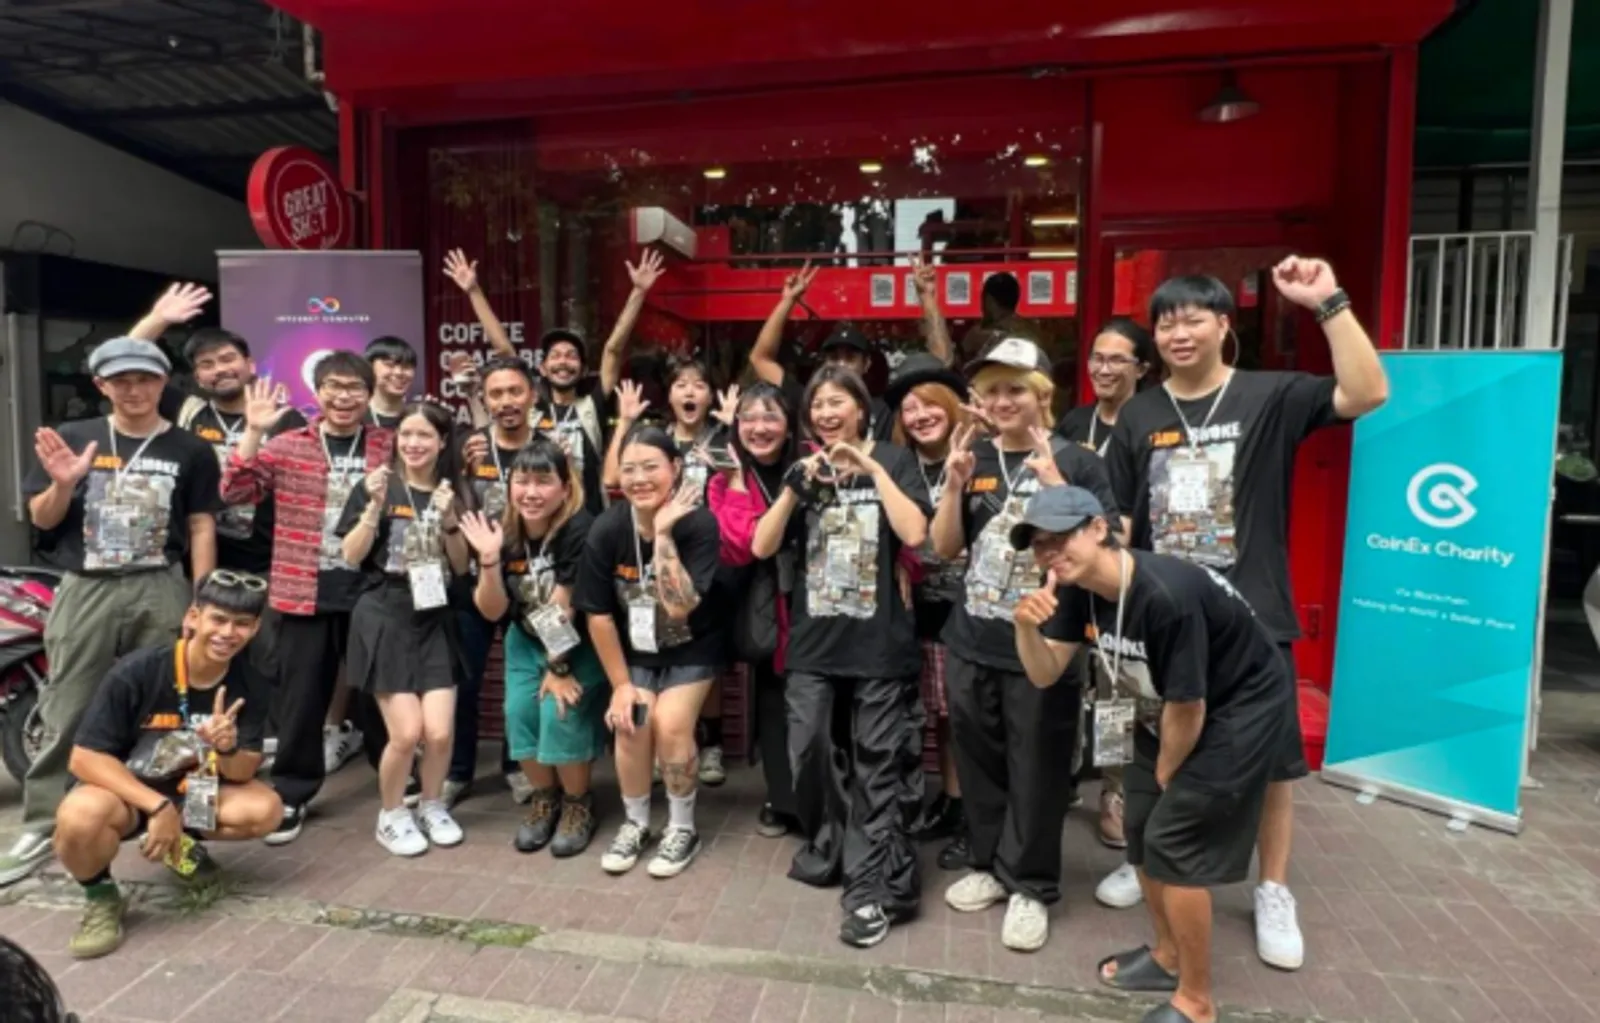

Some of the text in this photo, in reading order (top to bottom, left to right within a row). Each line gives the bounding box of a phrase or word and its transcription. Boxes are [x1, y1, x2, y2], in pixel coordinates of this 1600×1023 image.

[283, 180, 327, 218] GREAT
[439, 321, 525, 344] COFE
[1366, 533, 1515, 568] CoinEx Charity
